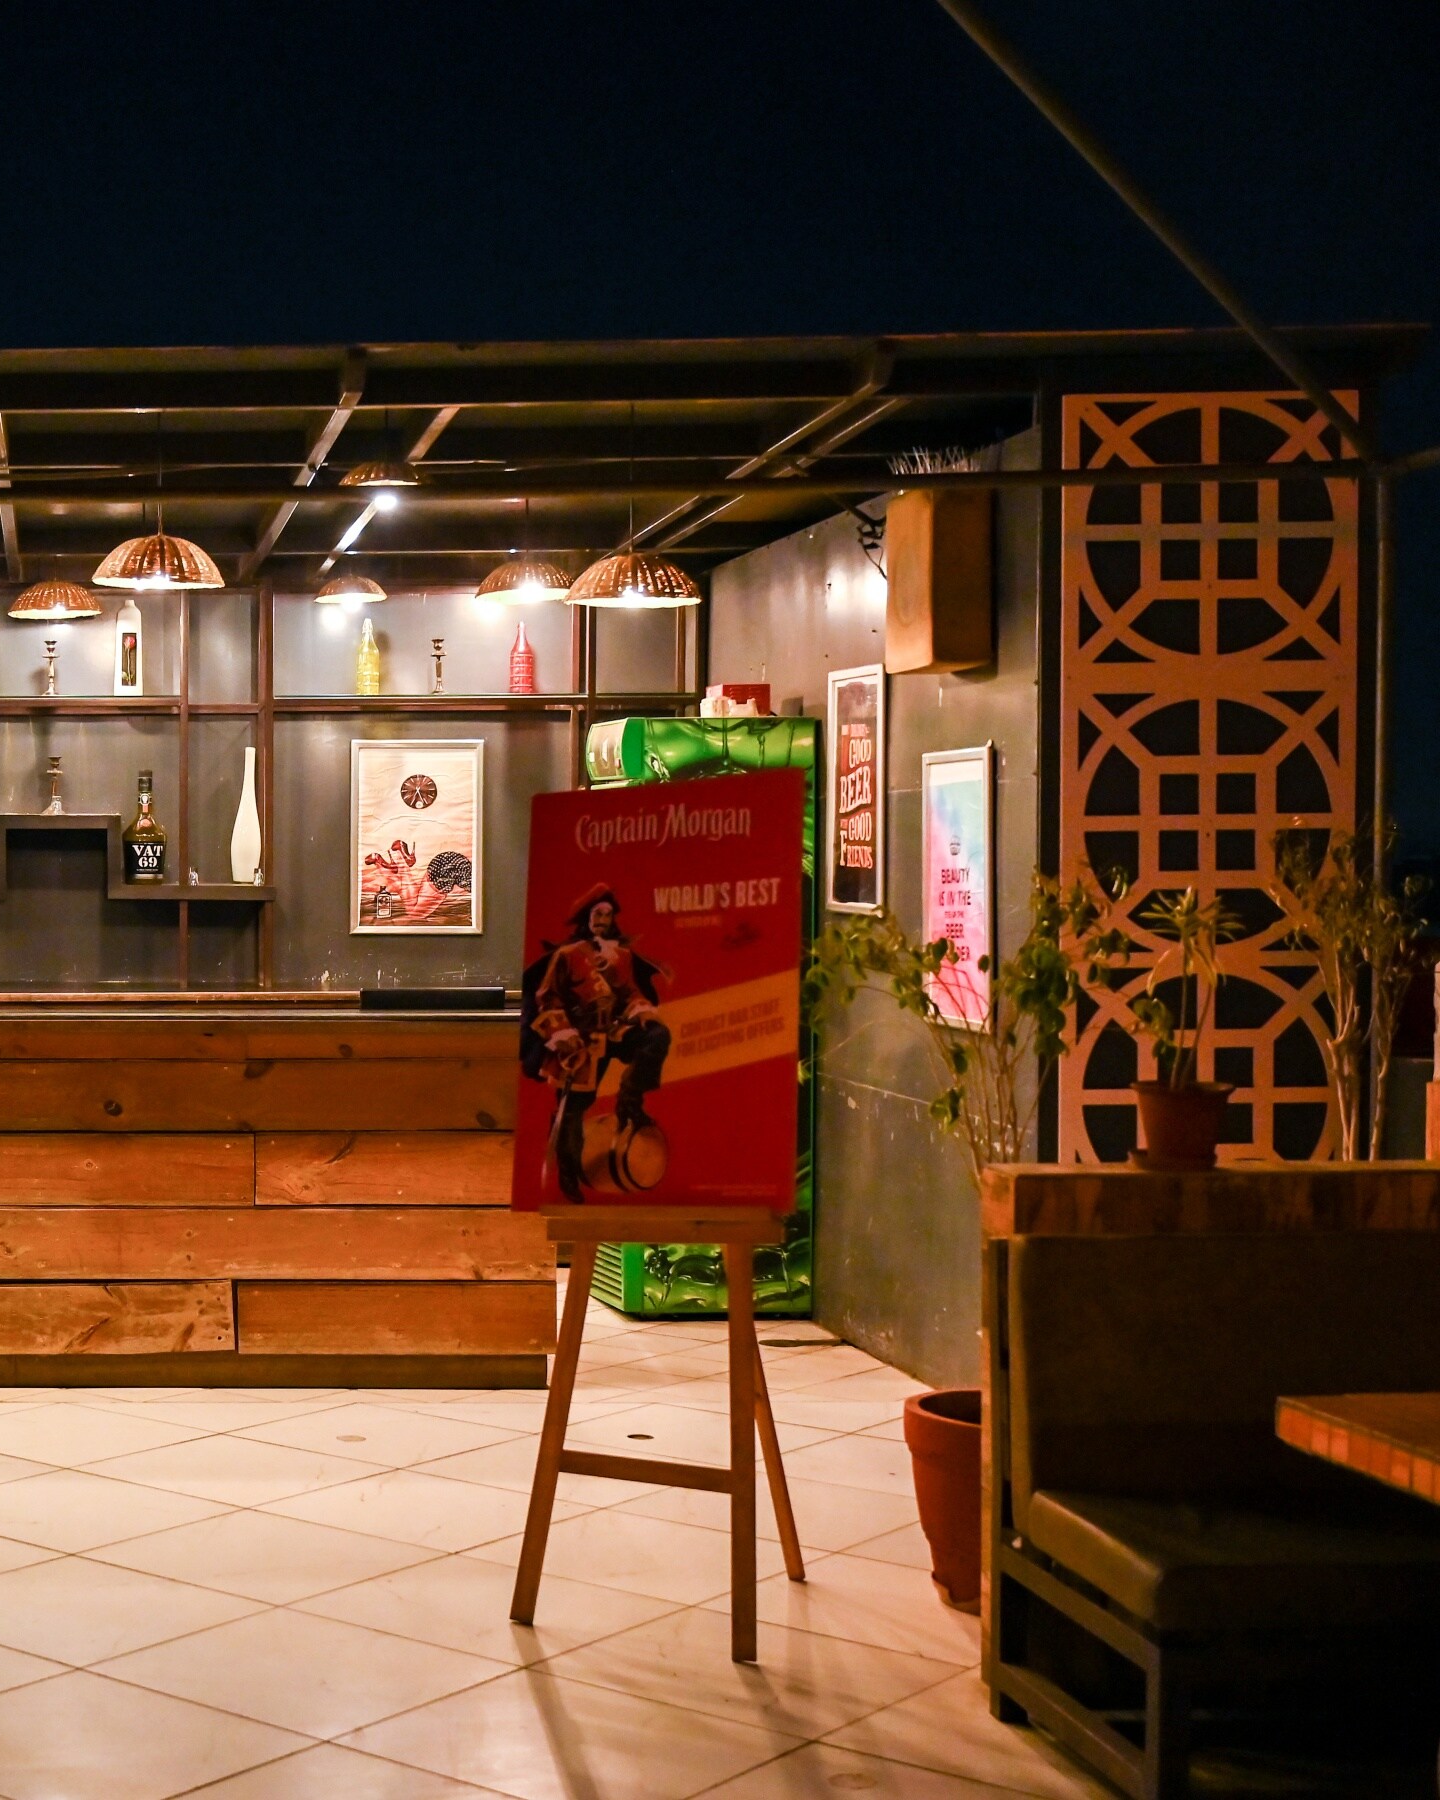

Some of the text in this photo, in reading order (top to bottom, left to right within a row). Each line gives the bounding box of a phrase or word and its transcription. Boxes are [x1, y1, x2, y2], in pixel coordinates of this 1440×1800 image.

[849, 738, 872, 768] GOOD
[839, 765, 872, 813] BEER
[575, 802, 751, 855] Captain Morgan
[848, 811, 872, 841] GOOD
[132, 844, 163, 857] VAT
[138, 856, 158, 868] 69
[941, 867, 970, 884] BEAUTY
[653, 877, 781, 914] WORLD'S BEST
